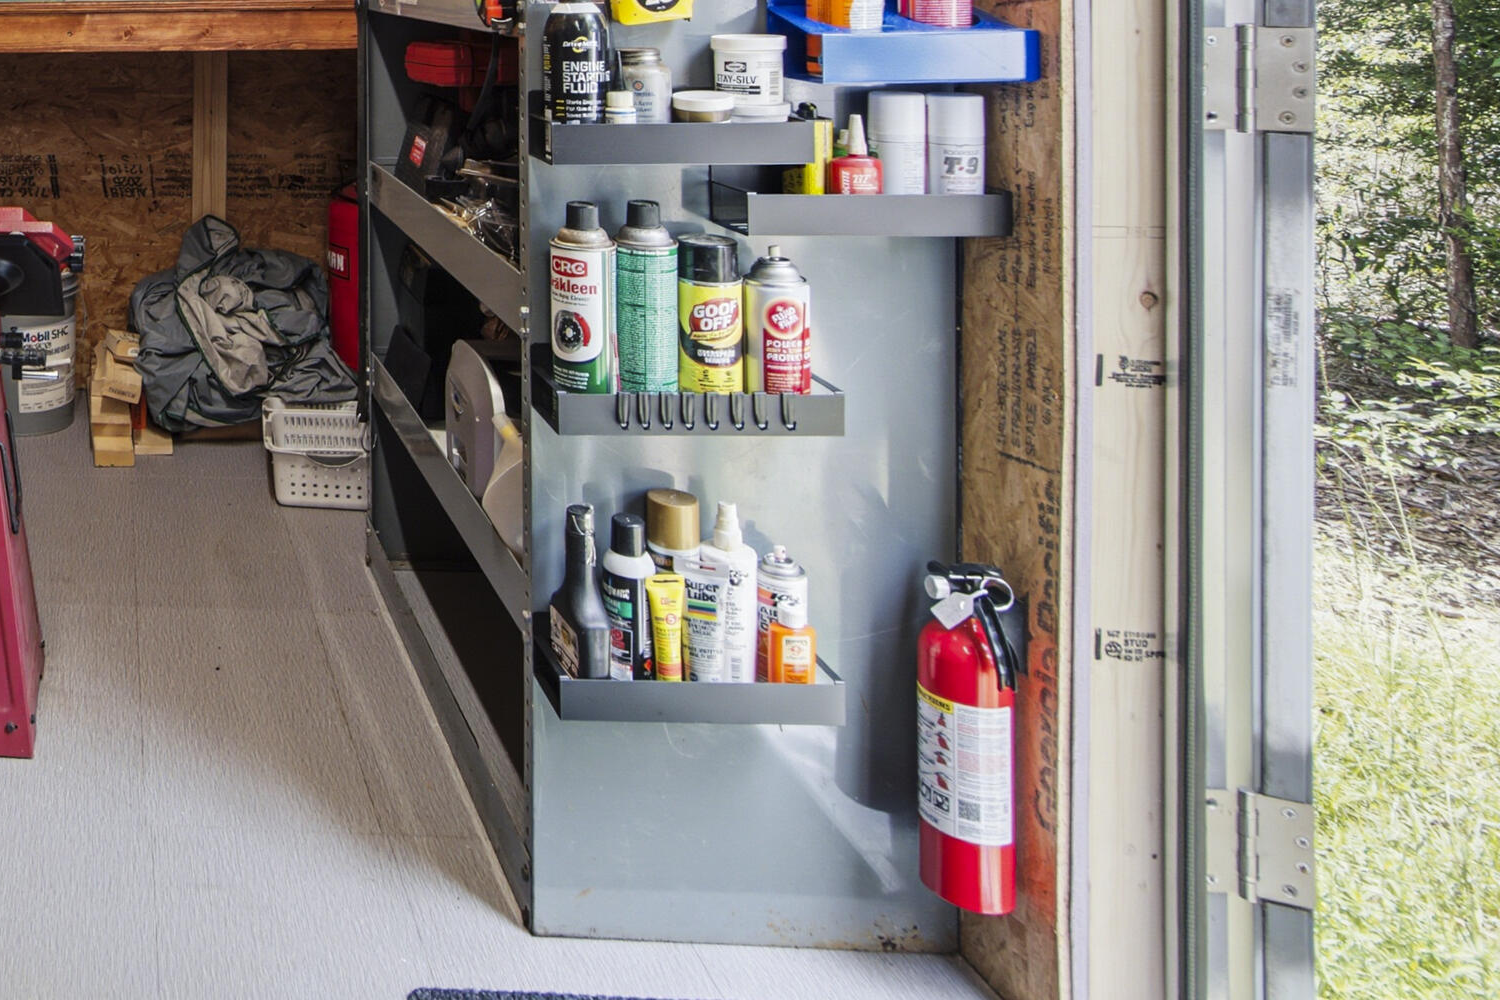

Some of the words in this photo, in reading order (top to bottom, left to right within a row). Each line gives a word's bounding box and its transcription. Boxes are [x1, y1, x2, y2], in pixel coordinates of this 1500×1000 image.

[562, 61, 606, 72] ENGINE
[562, 82, 599, 94] FLUID
[552, 257, 586, 276] CRC
[693, 300, 738, 318] GOOF
[700, 314, 733, 331] OFF
[51, 325, 69, 340] SHC
[684, 578, 720, 593] Super
[687, 587, 717, 603] Lube
[1123, 639, 1149, 648] STUD
